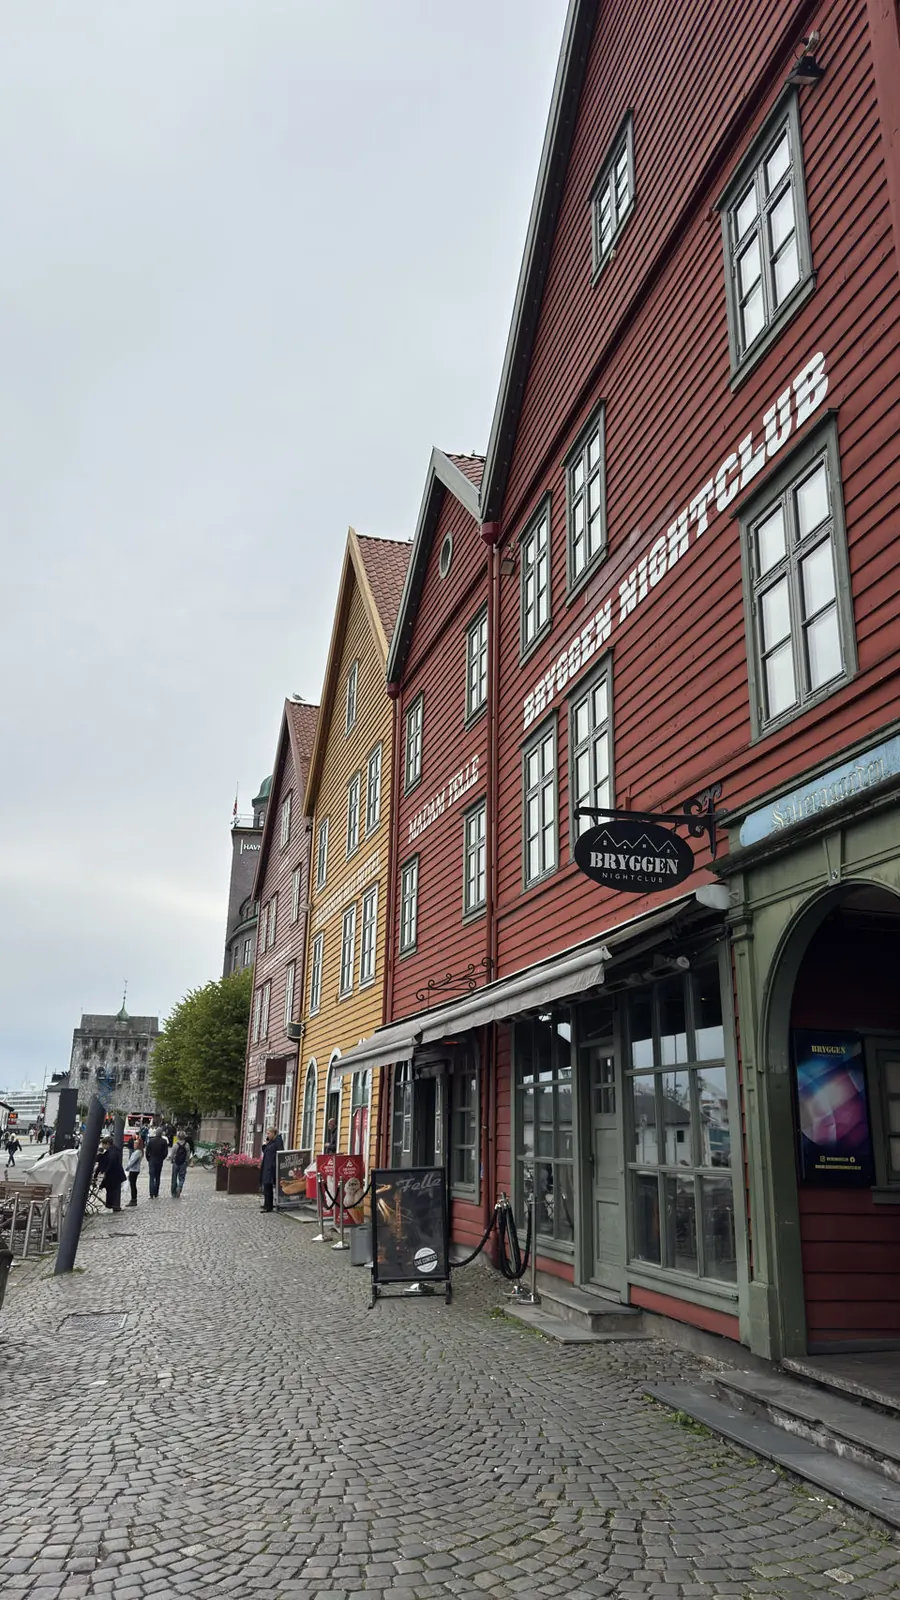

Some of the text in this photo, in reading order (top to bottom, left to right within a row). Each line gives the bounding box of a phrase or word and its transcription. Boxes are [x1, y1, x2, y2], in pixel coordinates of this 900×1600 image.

[523, 351, 829, 731] BRYGGEN NIGHTCLUB
[589, 851, 679, 875] BRYGGEN
[601, 872, 664, 883] NIGHTCLUB
[810, 1045, 846, 1055] BRYGGEN
